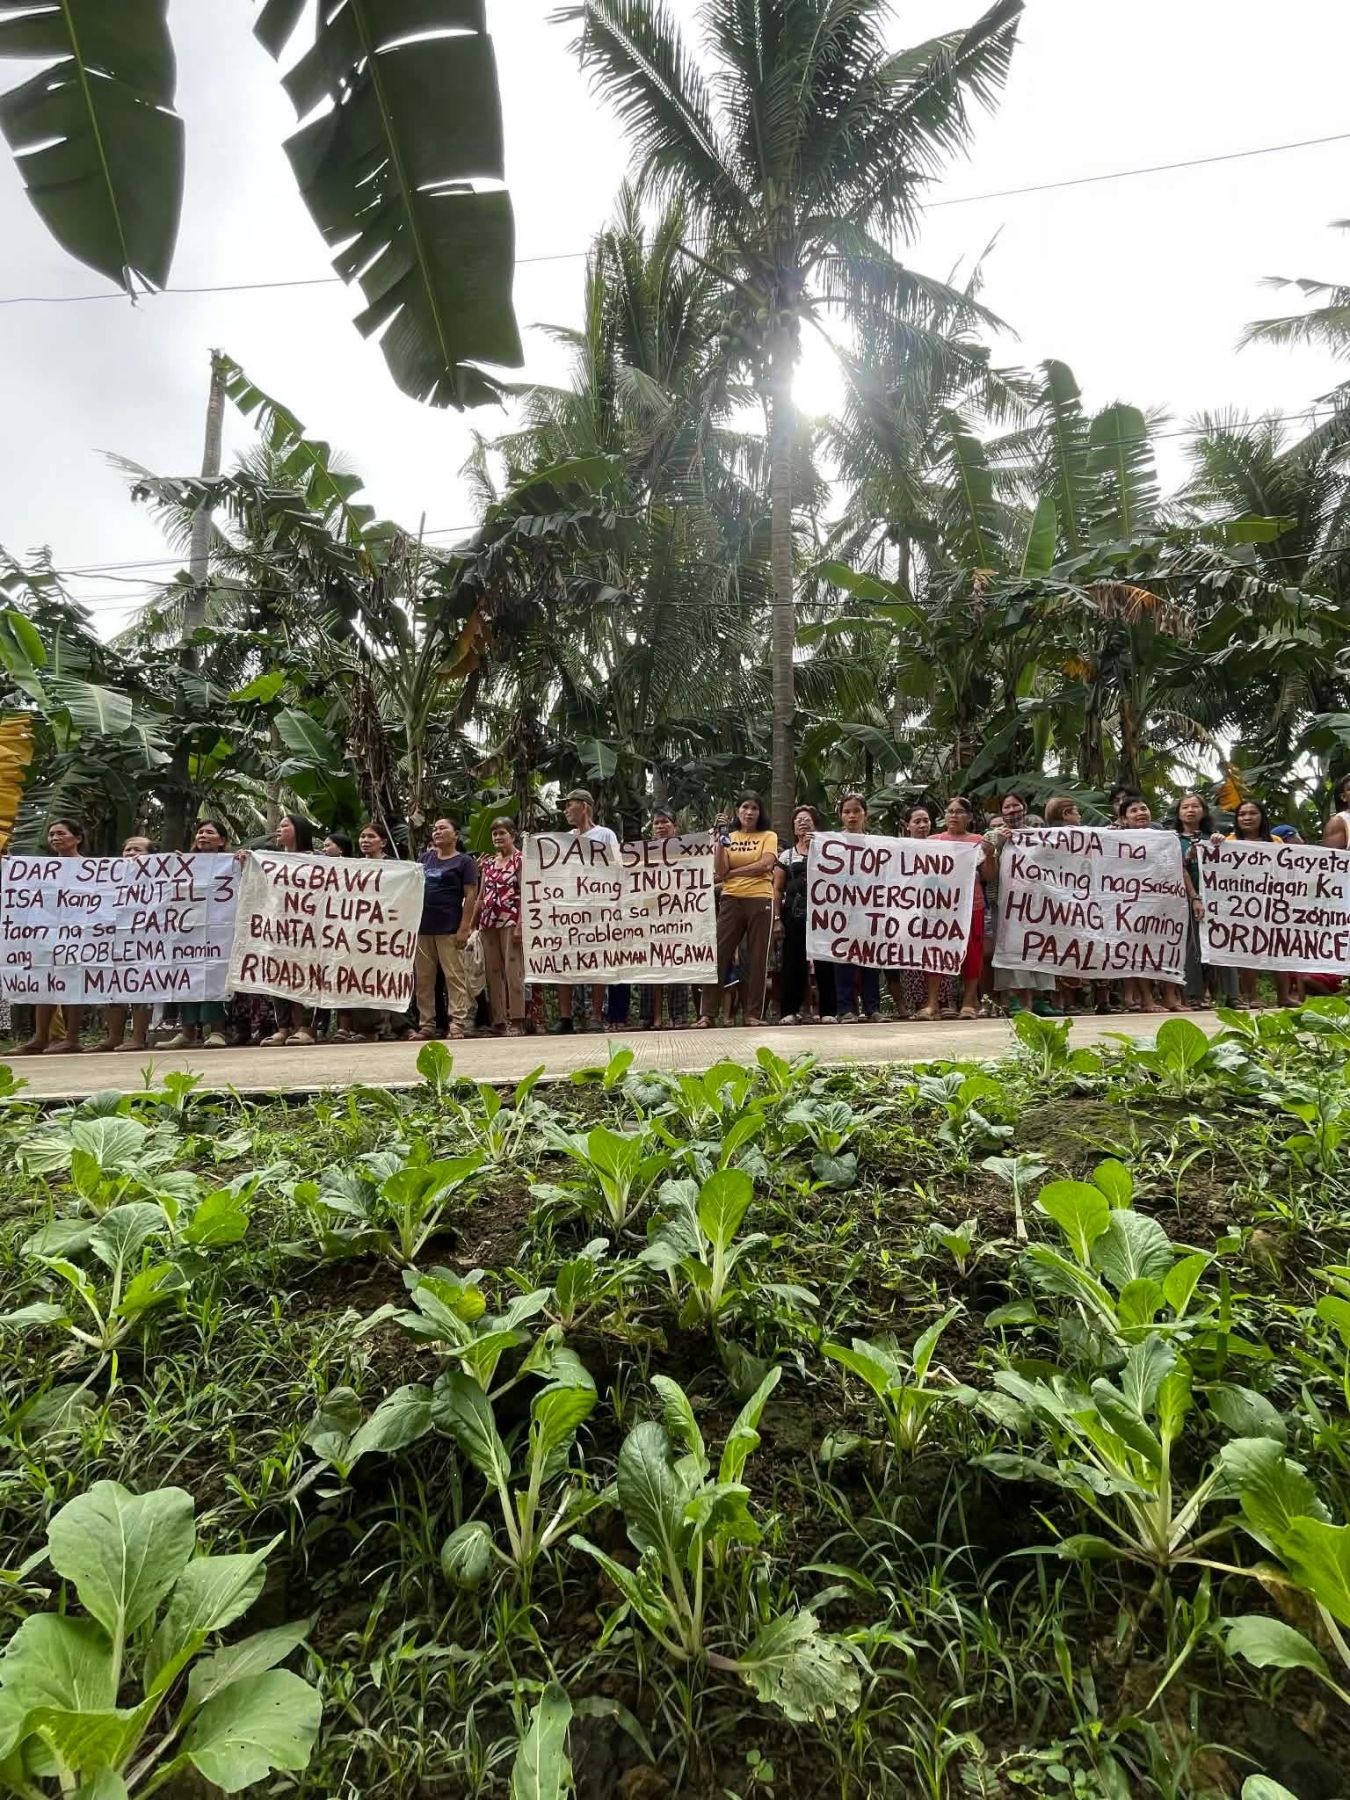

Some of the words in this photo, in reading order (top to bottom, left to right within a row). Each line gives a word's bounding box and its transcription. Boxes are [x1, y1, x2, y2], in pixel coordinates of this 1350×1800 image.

[536, 836, 610, 870] DAR
[619, 835, 682, 868] SEC
[817, 839, 893, 877] STOP
[900, 851, 955, 876] LAND
[1118, 842, 1147, 860] na
[1202, 845, 1272, 870] Mayor
[1276, 847, 1350, 874] Gayeta
[9, 859, 62, 881] DAR
[76, 859, 124, 883] SEC
[135, 855, 196, 879] XXX
[260, 860, 384, 893] PAGBAWI
[1010, 853, 1091, 901] Kaming
[4, 888, 44, 909] ISA
[112, 878, 206, 907] INUTIL
[214, 876, 234, 902] 3
[526, 880, 565, 904] Isa
[630, 868, 712, 894] INUTIL
[810, 878, 961, 912] CONVERSION!
[284, 891, 316, 917] NG
[529, 908, 543, 930] 3
[548, 906, 592, 927] taon
[601, 908, 623, 922] na
[629, 906, 649, 918] sa
[657, 892, 710, 917] PARC
[1005, 890, 1104, 930] HUWAG
[1115, 903, 1184, 946] Kaming
[1227, 895, 1290, 925] 2018
[2, 915, 49, 940] taon
[58, 925, 82, 939] na
[92, 923, 117, 937] sa
[130, 908, 195, 934] PARC
[250, 913, 317, 949] BANTA
[322, 924, 350, 954] SA
[356, 928, 417, 959] SEGU
[531, 935, 562, 951] Ang
[568, 923, 644, 946] Problema
[649, 919, 693, 935] namin
[811, 908, 847, 935] NO
[864, 912, 900, 939] TO
[907, 916, 965, 941] CLOA
[1207, 918, 1350, 961] ORDINANCE
[6, 950, 32, 970] ang
[53, 940, 167, 966] PROBLEMA
[172, 941, 221, 959] namin
[529, 952, 572, 975] WALA
[576, 951, 599, 970] KA
[603, 949, 648, 969] NAMAN
[650, 941, 715, 968] MAGAWA
[830, 937, 966, 973] CANCELLATION
[3, 972, 39, 993] Wala
[84, 967, 192, 994] MAGAWA
[240, 953, 306, 991] RIDAD
[309, 963, 332, 992] NG
[336, 966, 414, 1000] PAGKAIN
